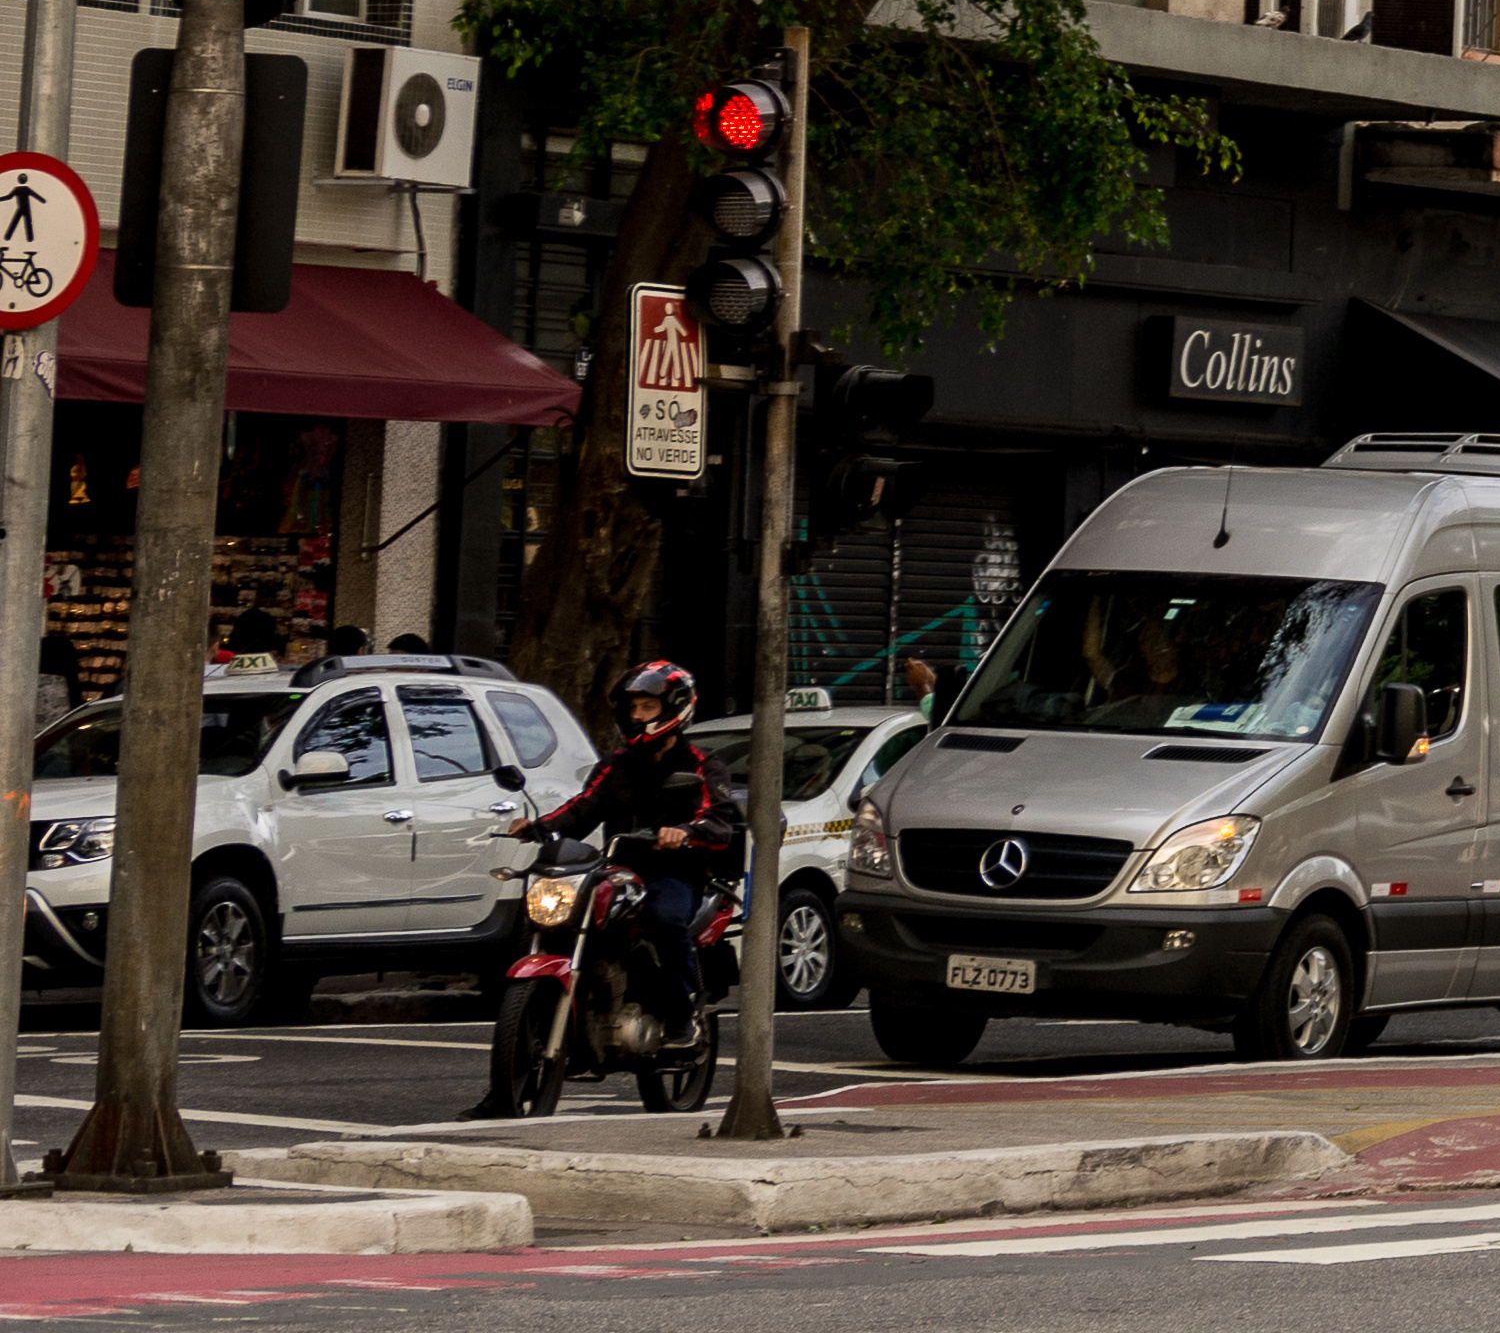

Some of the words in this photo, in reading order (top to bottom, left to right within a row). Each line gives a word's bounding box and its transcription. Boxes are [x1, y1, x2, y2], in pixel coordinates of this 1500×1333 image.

[1180, 330, 1296, 395] Collins
[655, 394, 681, 422] SÓ
[635, 426, 699, 444] ATRAVESSE
[636, 447, 652, 462] NO
[658, 448, 697, 464] VERDE
[230, 655, 267, 669] TAXI
[788, 691, 818, 707] TAXI
